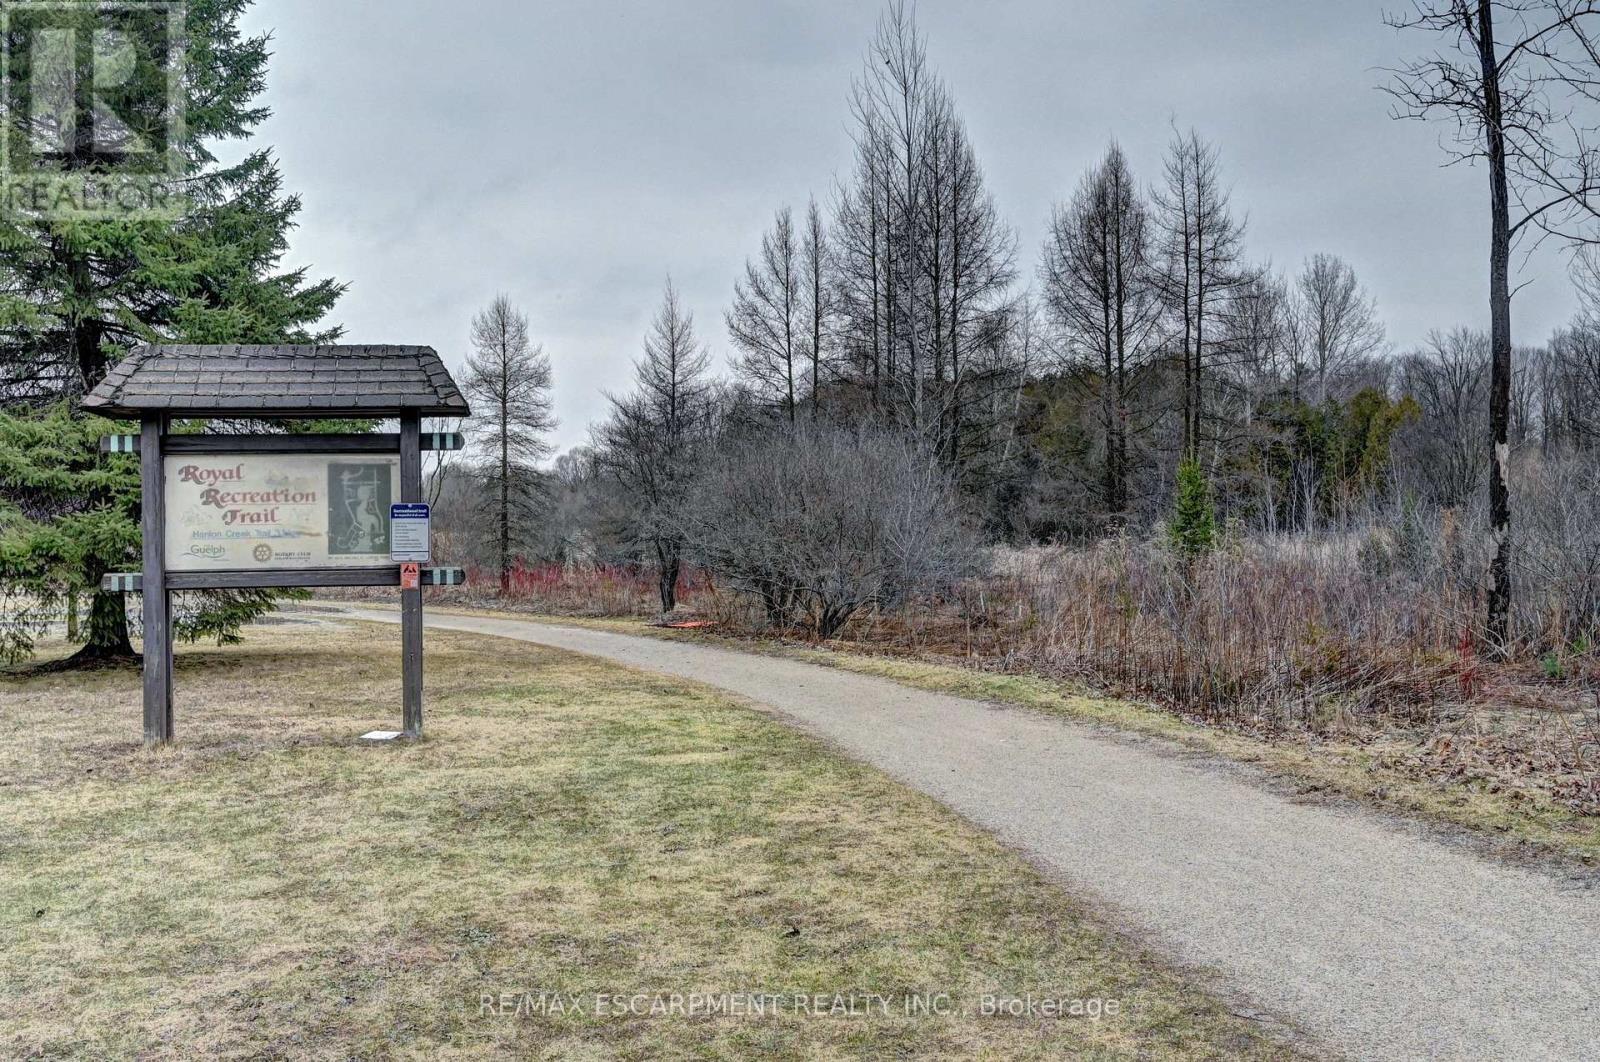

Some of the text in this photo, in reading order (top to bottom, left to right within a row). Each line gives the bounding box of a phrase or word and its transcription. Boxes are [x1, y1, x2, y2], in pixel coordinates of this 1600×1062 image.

[178, 463, 245, 487] Royal
[200, 488, 317, 509] Recreation
[222, 506, 280, 526] Trail
